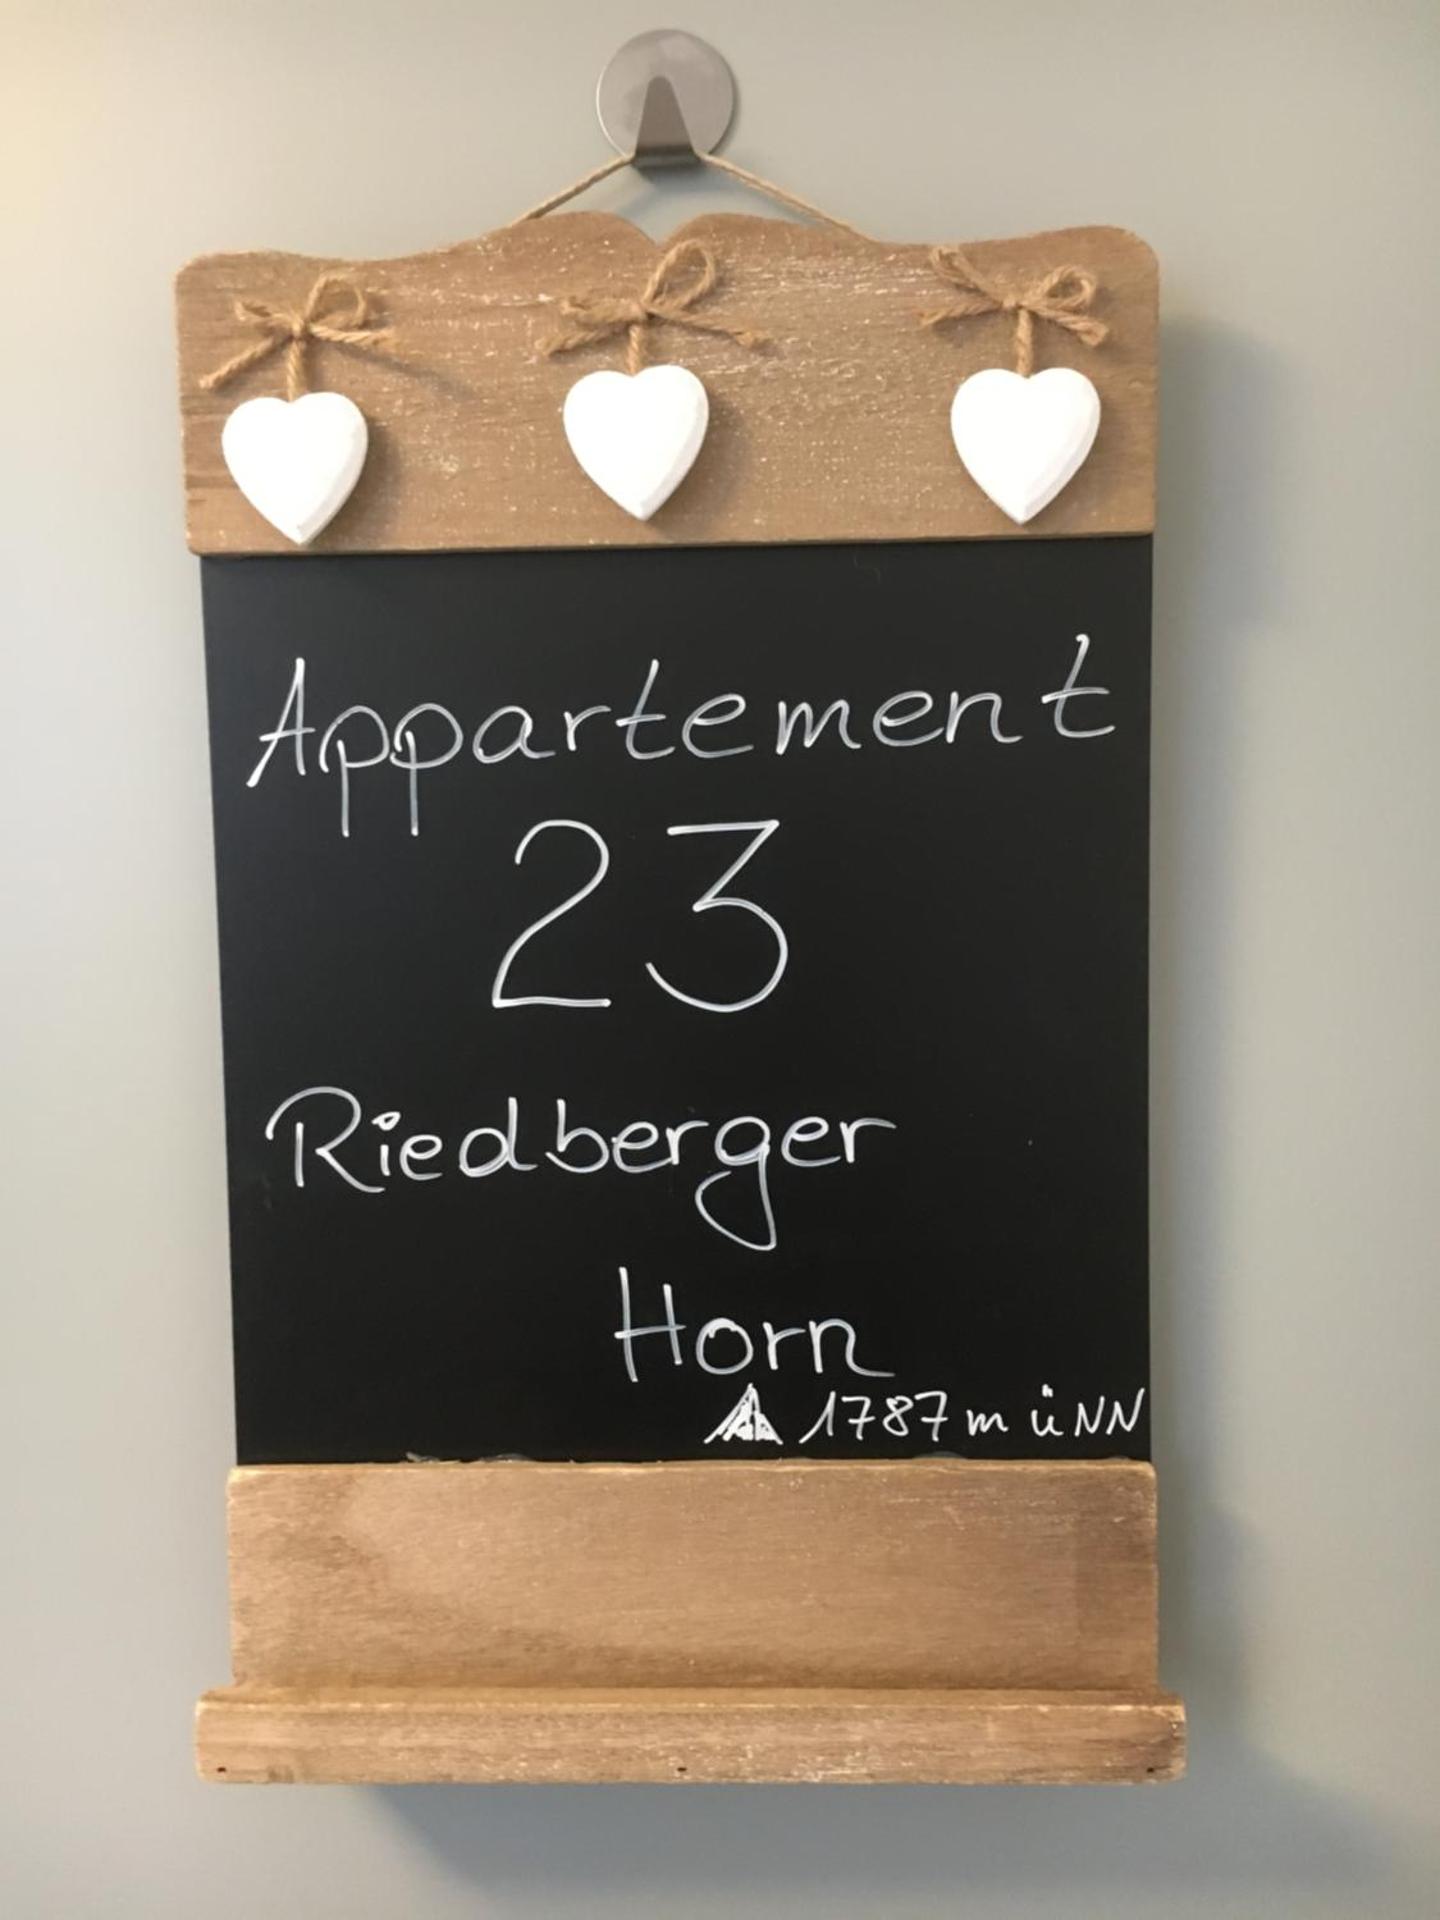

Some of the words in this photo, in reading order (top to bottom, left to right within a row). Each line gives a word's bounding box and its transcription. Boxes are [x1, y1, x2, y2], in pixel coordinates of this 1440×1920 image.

[246, 634, 1116, 838] Appartement
[491, 818, 789, 1013] 23
[265, 1086, 897, 1252] Riedberger
[613, 1266, 894, 1383] Horn
[799, 1390, 949, 1444] 1787
